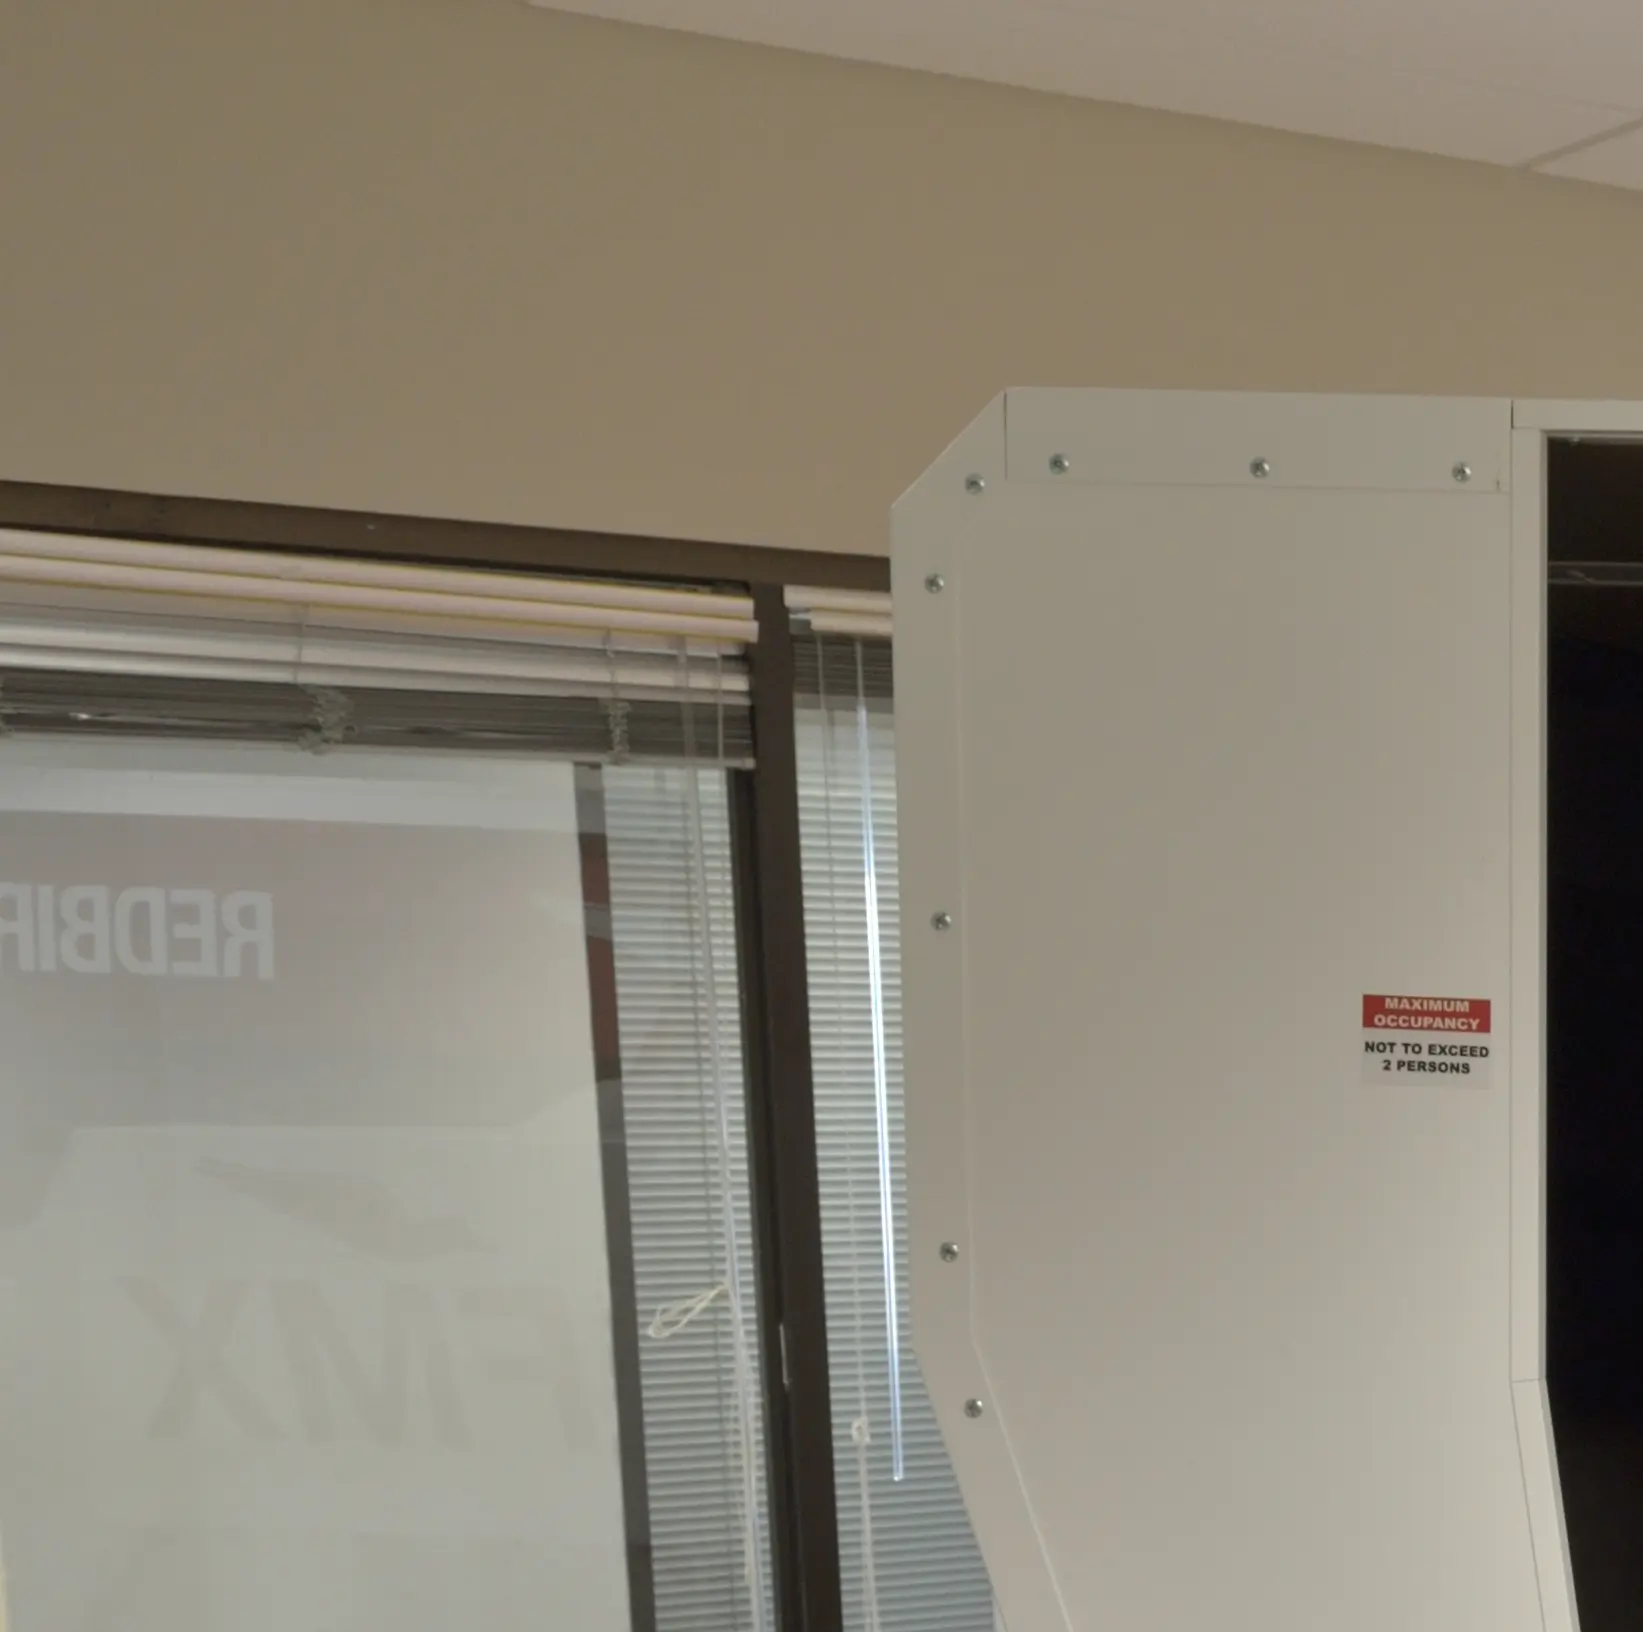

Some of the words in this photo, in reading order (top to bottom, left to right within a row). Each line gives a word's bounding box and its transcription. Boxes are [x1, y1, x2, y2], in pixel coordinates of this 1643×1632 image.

[1384, 997, 1470, 1013] MAXIMUM
[1374, 1014, 1480, 1030] OCCUPANCY
[1364, 1041, 1397, 1053] NOT
[1402, 1042, 1422, 1055] TO
[1428, 1044, 1490, 1058] EXCEED
[1382, 1059, 1392, 1071] 2
[1397, 1060, 1471, 1074] PERSONS
